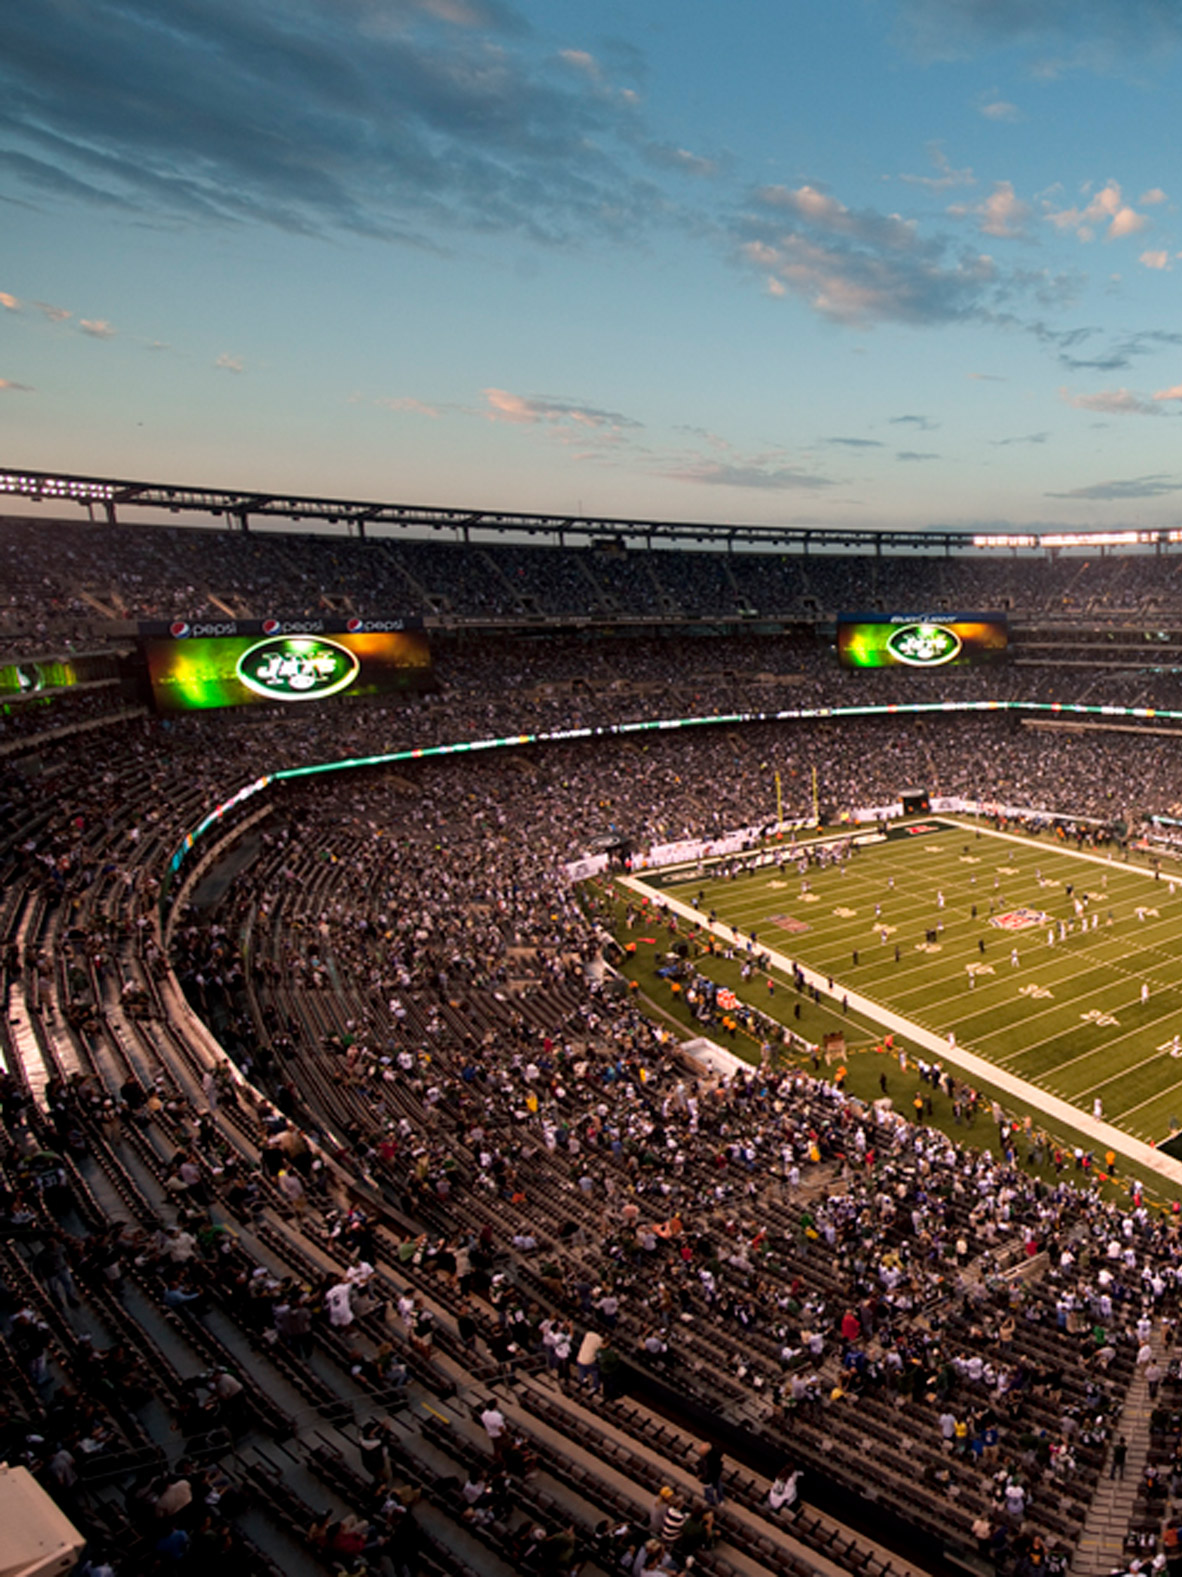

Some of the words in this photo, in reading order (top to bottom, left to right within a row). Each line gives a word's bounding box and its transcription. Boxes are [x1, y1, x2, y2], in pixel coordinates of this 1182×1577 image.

[193, 622, 237, 636] pepsi
[282, 619, 324, 632] pepsi
[365, 618, 404, 631] pepsi
